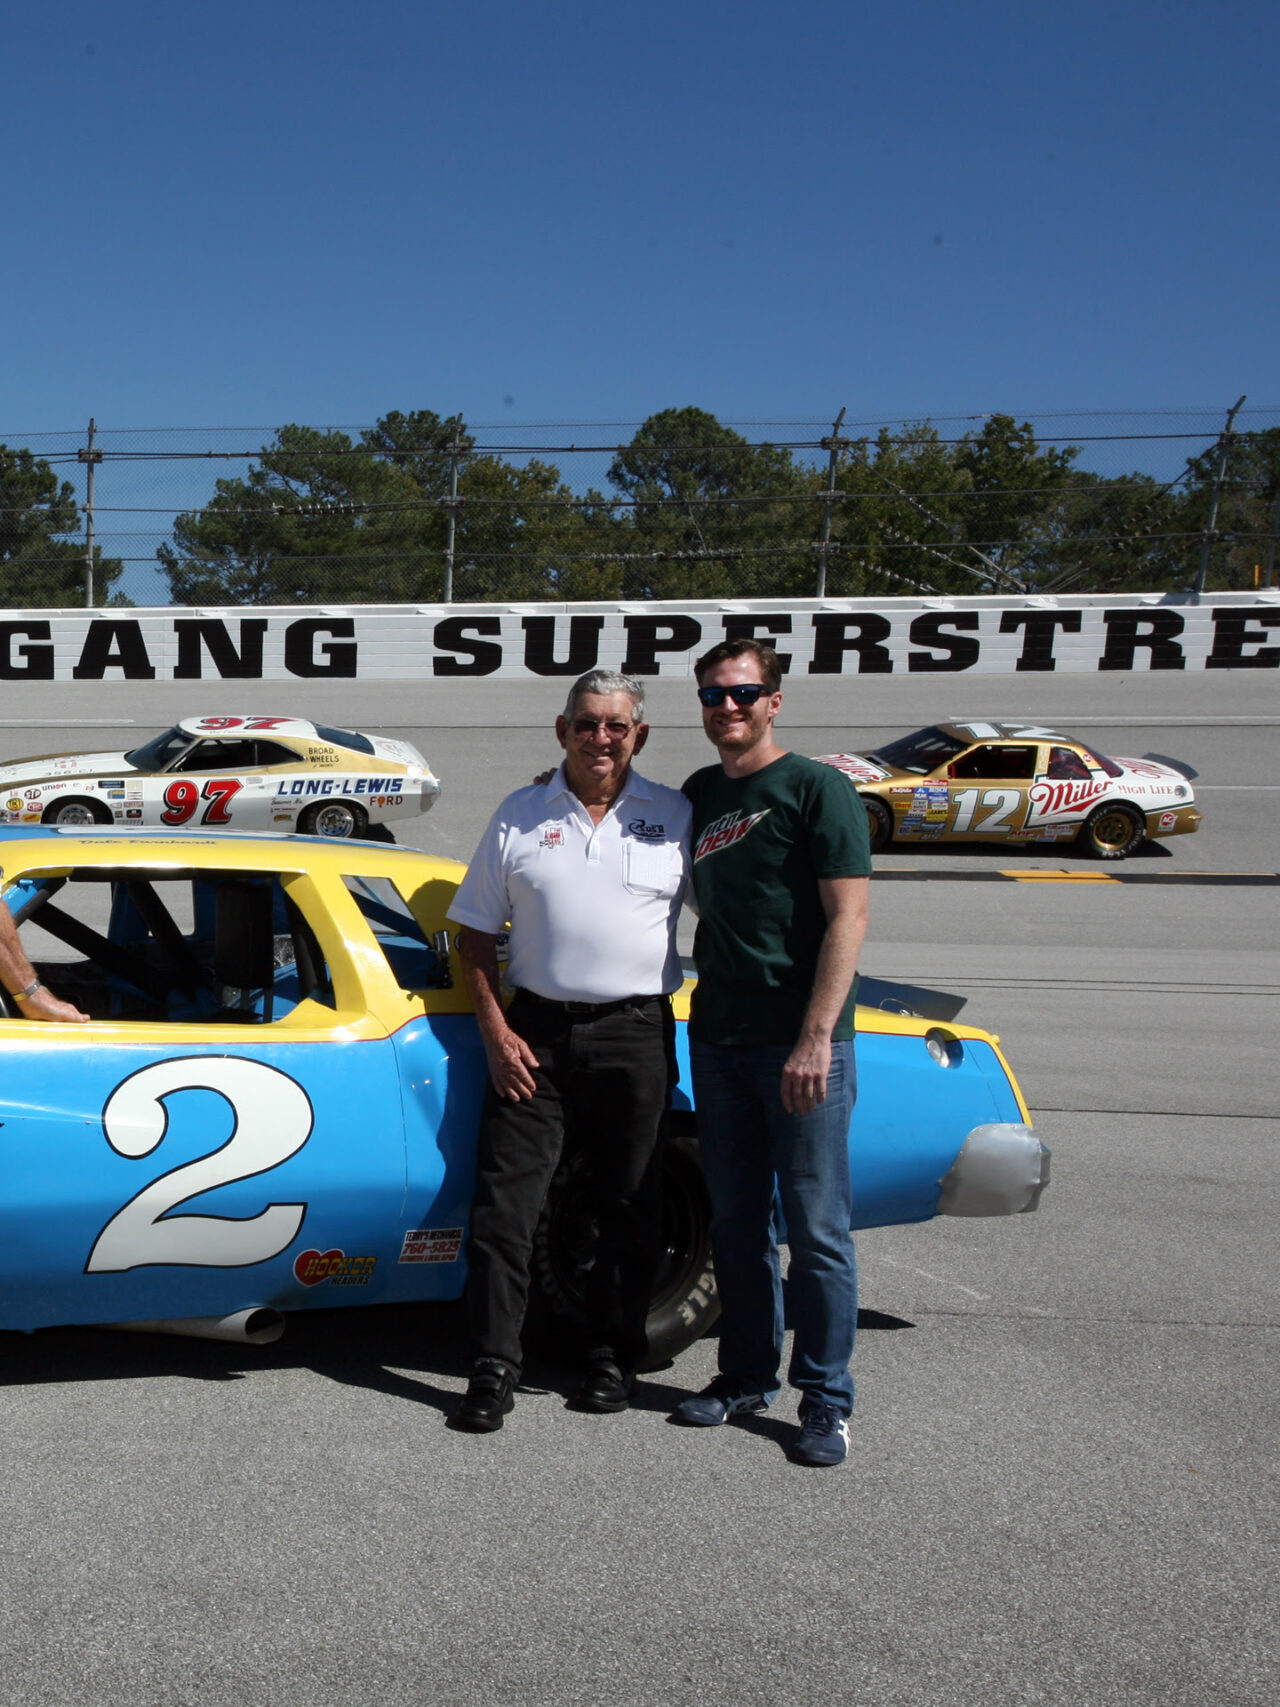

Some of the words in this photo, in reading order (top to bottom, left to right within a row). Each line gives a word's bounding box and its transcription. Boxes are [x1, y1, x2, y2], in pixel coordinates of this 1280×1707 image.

[196, 716, 296, 731] 97
[310, 755, 340, 763] WHEELS
[160, 778, 244, 826] 97
[951, 788, 1021, 834] 12
[1028, 780, 1115, 817] Miller
[1118, 784, 1146, 795] HIGH
[1150, 784, 1174, 795] LIFE
[83, 1053, 315, 1275] 2
[304, 1256, 377, 1277] HOOKER
